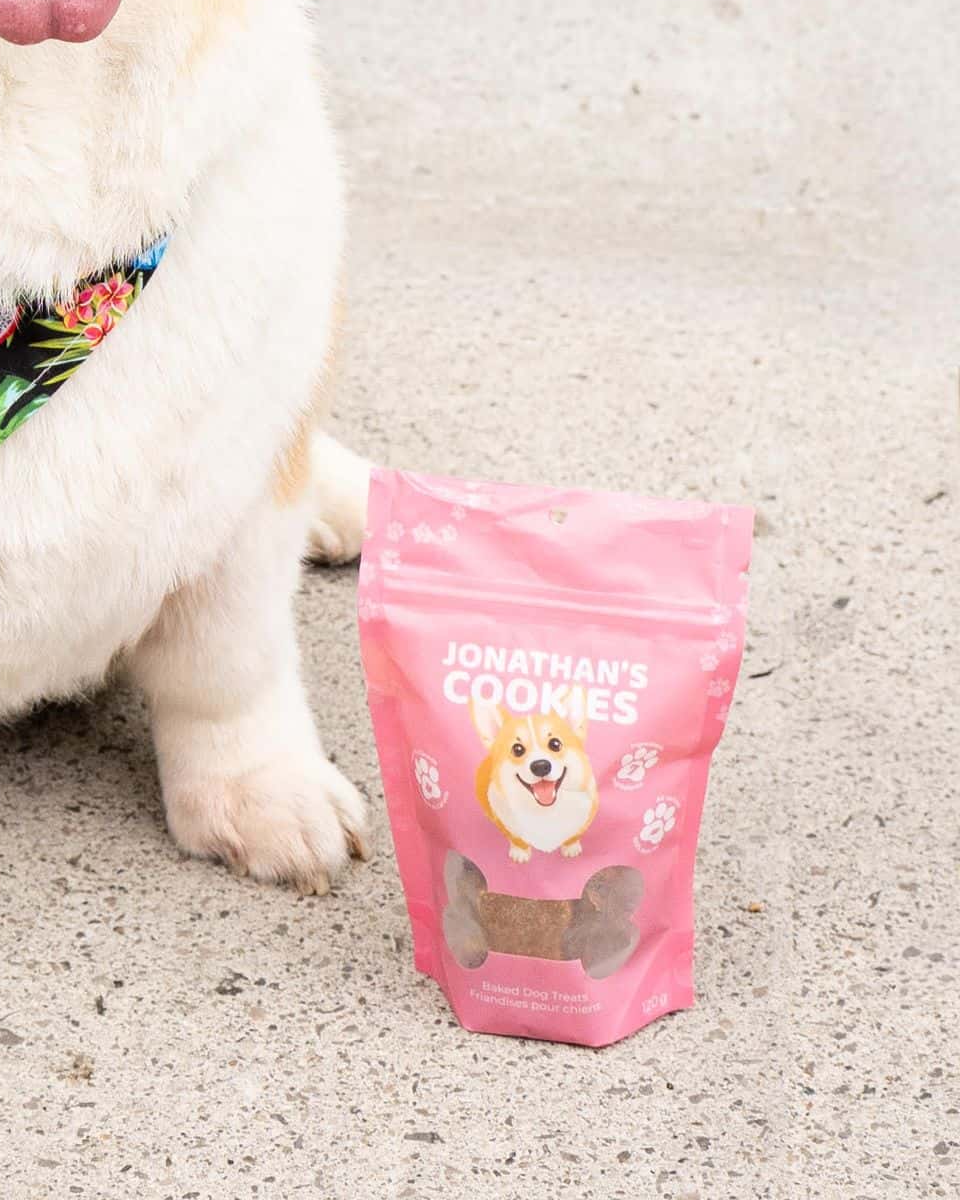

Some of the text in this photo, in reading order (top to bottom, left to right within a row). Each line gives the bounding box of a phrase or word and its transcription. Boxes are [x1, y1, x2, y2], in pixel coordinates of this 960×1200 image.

[442, 641, 648, 689] JONATHAN'S
[443, 670, 638, 725] COOKIES
[482, 980, 589, 1003] Baked Dog Treats
